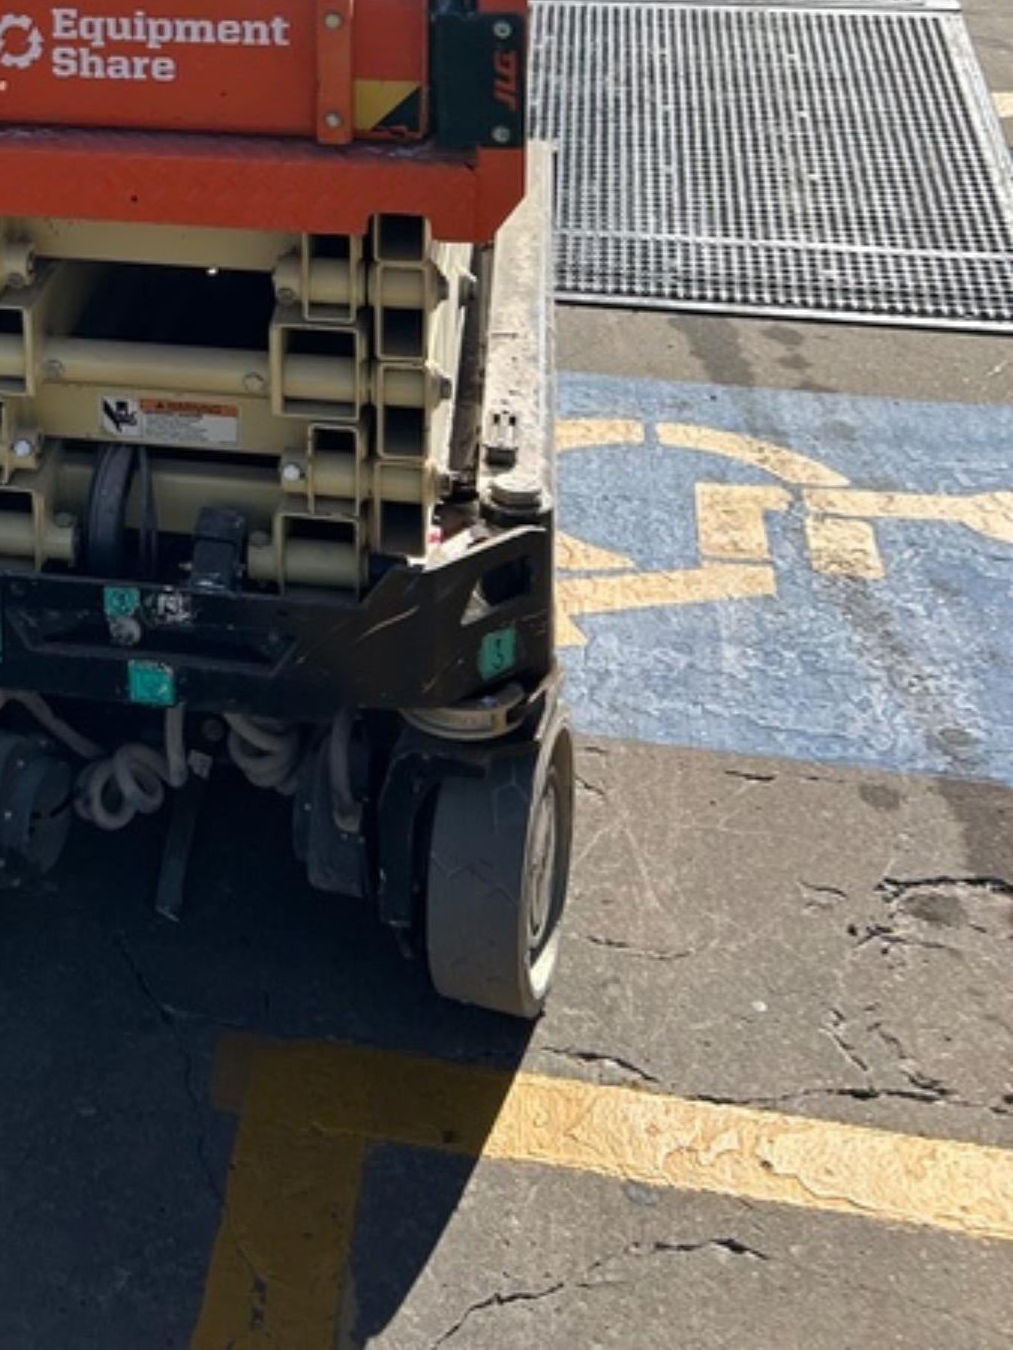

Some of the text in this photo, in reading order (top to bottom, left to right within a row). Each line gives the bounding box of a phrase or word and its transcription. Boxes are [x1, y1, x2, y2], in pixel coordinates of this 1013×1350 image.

[50, 7, 290, 49] Equipment
[50, 47, 177, 82] Share
[492, 50, 519, 112] JLG
